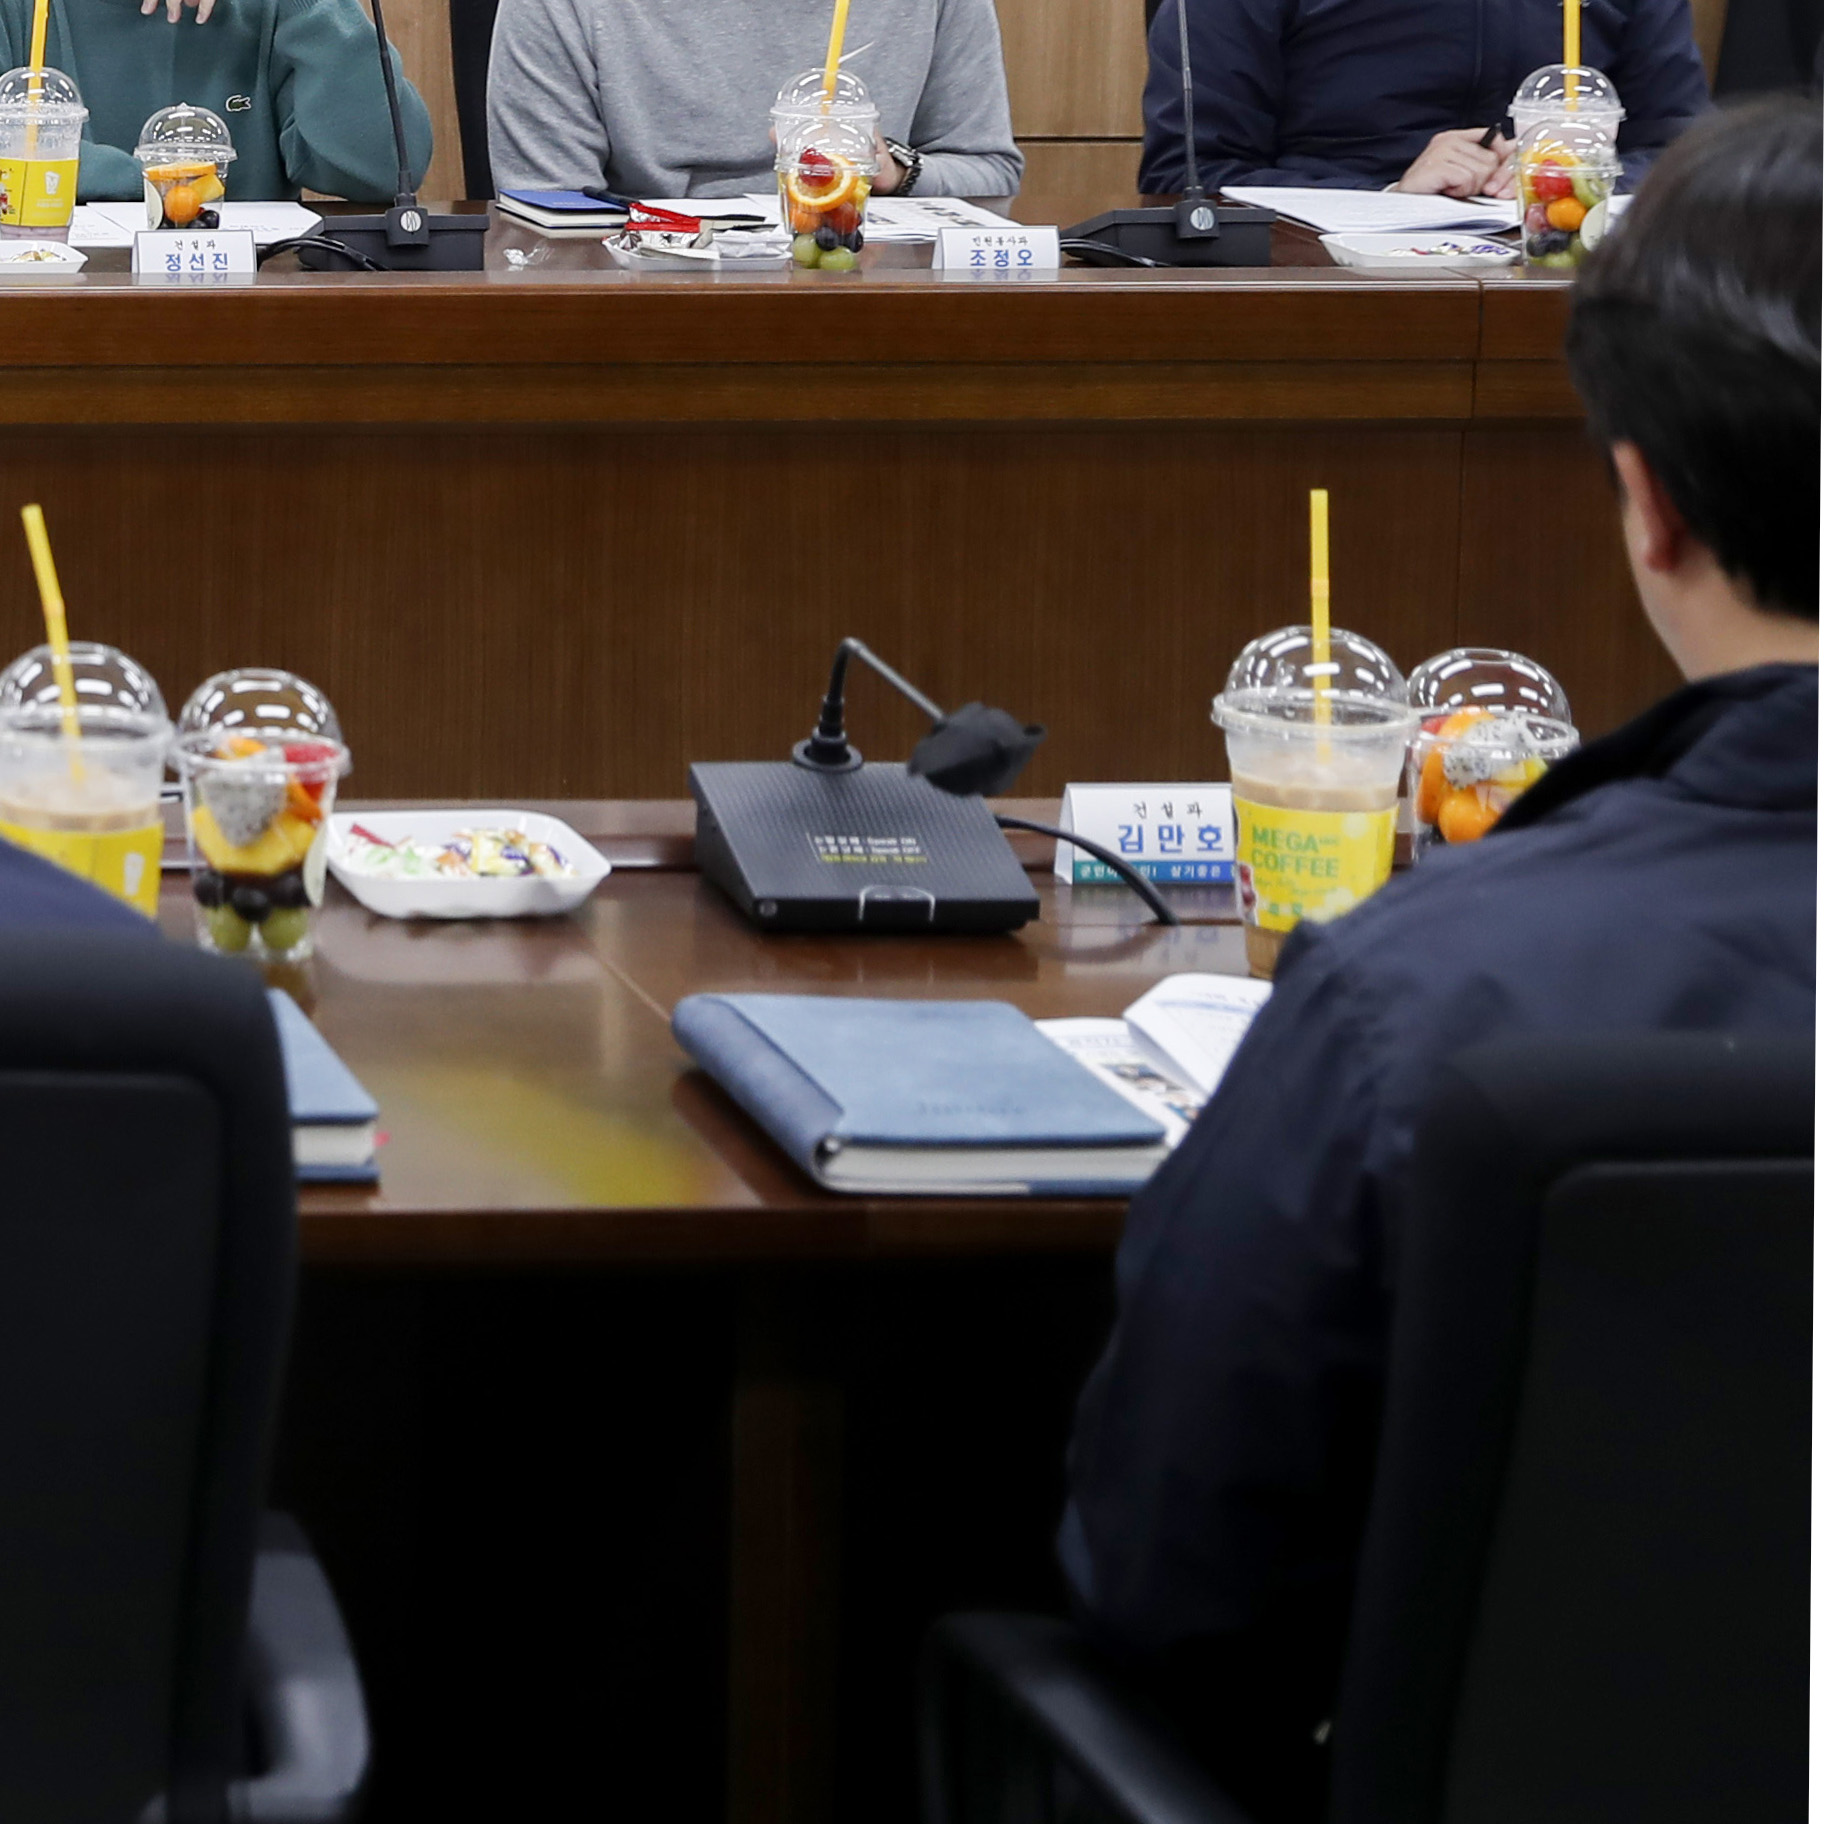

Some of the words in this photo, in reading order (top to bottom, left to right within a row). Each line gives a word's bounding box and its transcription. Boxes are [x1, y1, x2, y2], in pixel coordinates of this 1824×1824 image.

[165, 252, 229, 272] 정선진
[969, 249, 1034, 268] 조정오
[1117, 824, 1224, 854] 김만호
[1251, 825, 1320, 854] MEGA
[1251, 849, 1340, 879] COFFEE
